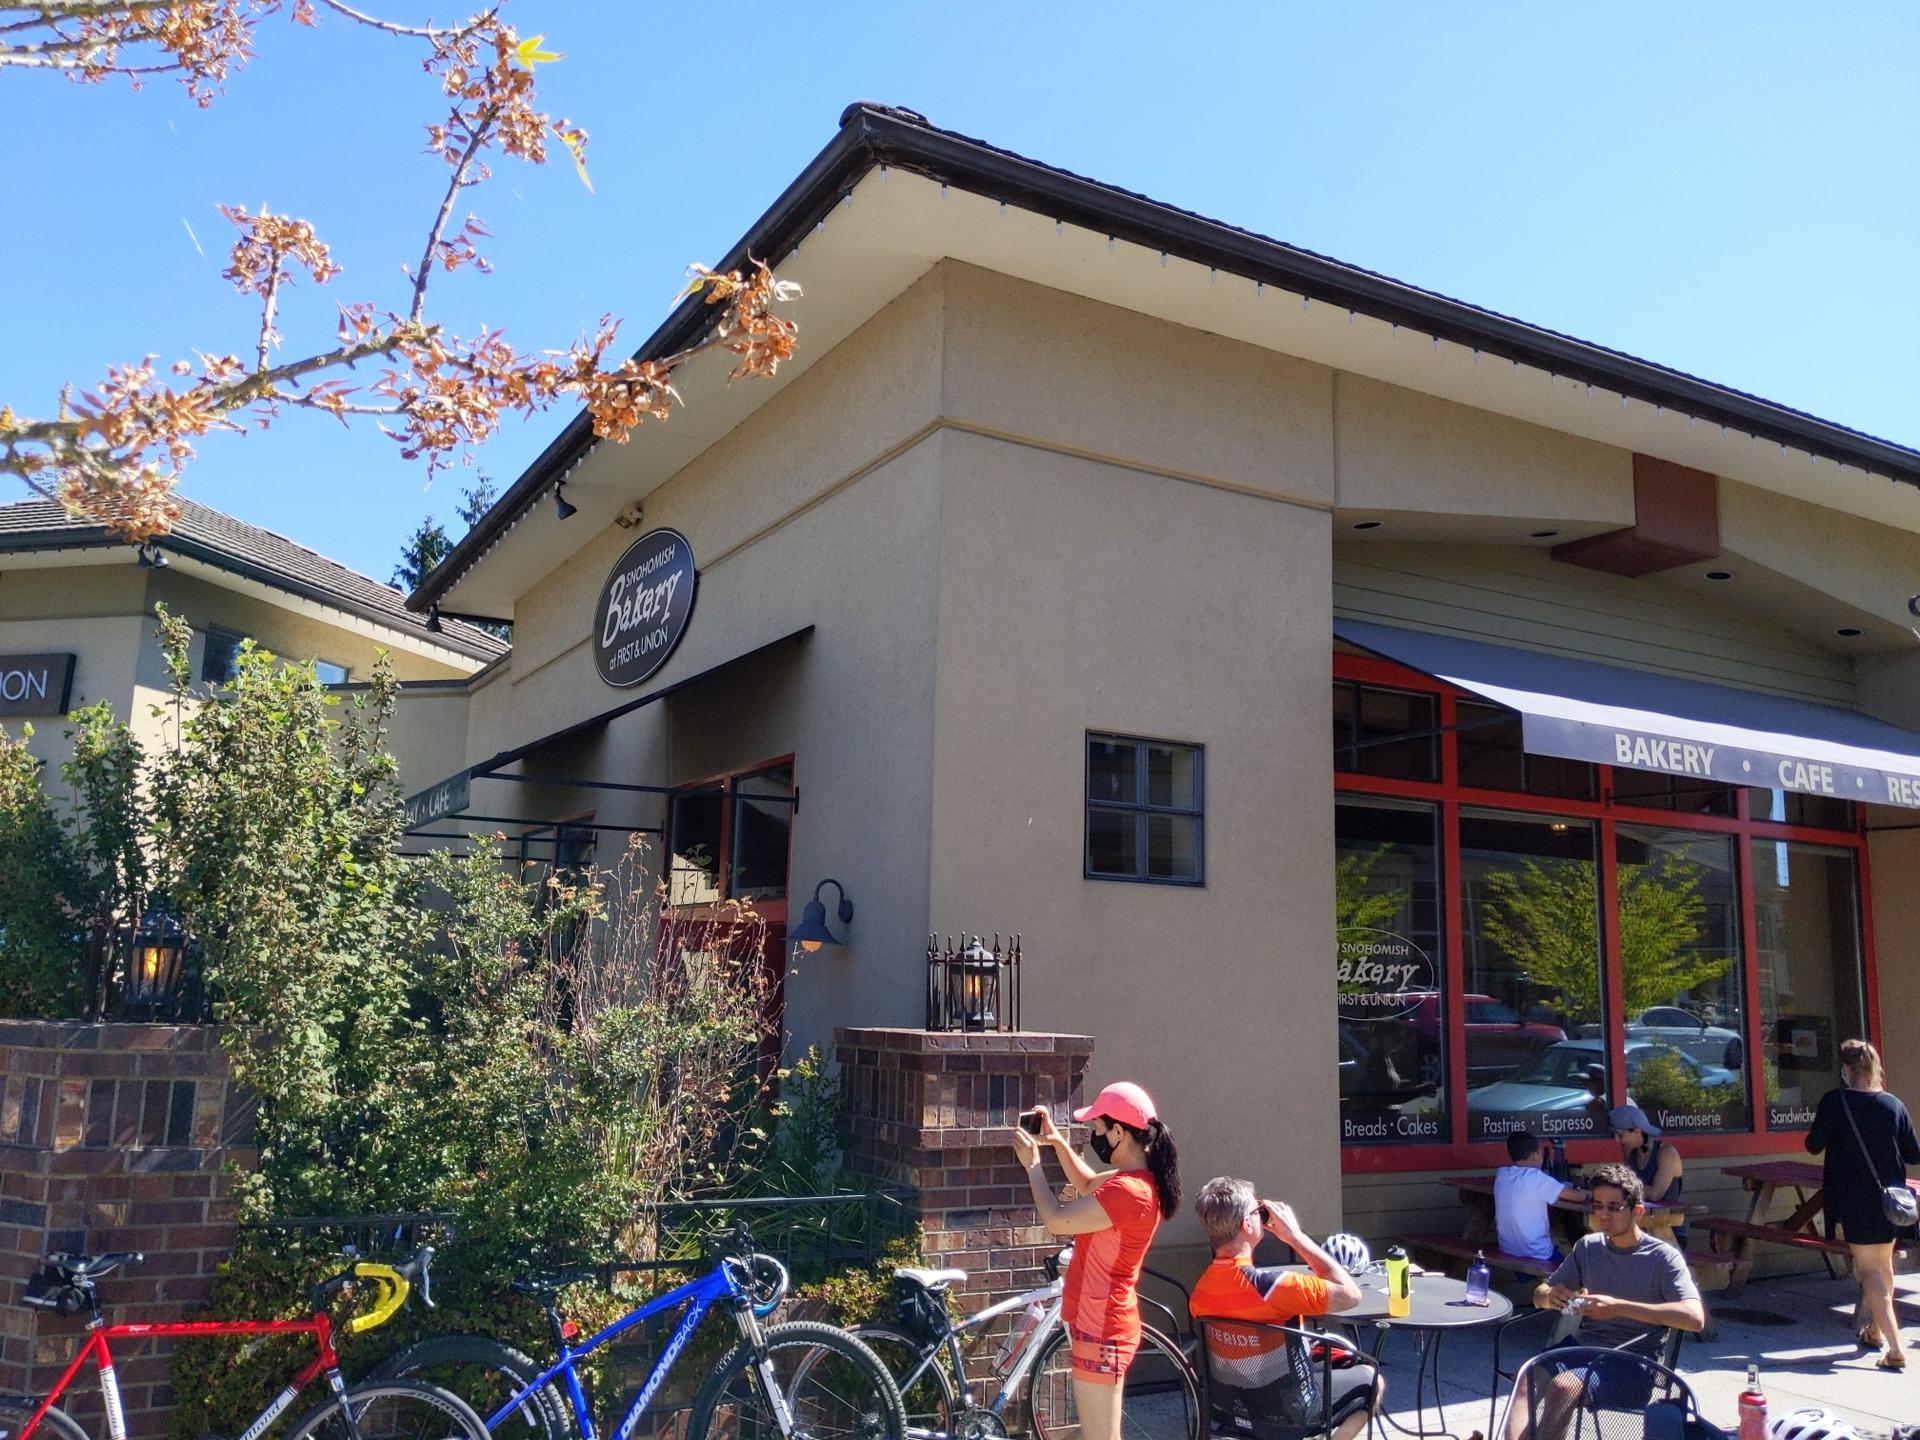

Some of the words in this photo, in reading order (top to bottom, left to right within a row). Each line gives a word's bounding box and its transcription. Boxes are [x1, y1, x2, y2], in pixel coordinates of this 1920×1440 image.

[625, 544, 676, 588] SNOHOMISH
[602, 569, 683, 649] Bakery
[616, 646, 634, 667] FIRST
[641, 625, 669, 655] UNION
[1615, 733, 1714, 776] BAKERY
[1778, 760, 1834, 793] CAFE
[1341, 943, 1409, 955] SNOHOMISH
[1336, 956, 1420, 991] akery
[1338, 993, 1359, 1006] IRST
[1370, 993, 1406, 1007] UNION
[1345, 1117, 1387, 1137] Breads
[1397, 1115, 1438, 1136] Cakes
[1483, 1116, 1526, 1133] Pastries
[1542, 1113, 1594, 1133] Espresso
[1657, 1109, 1721, 1128] Viennoiserie
[620, 1300, 703, 1440] DIAMONDBACK
